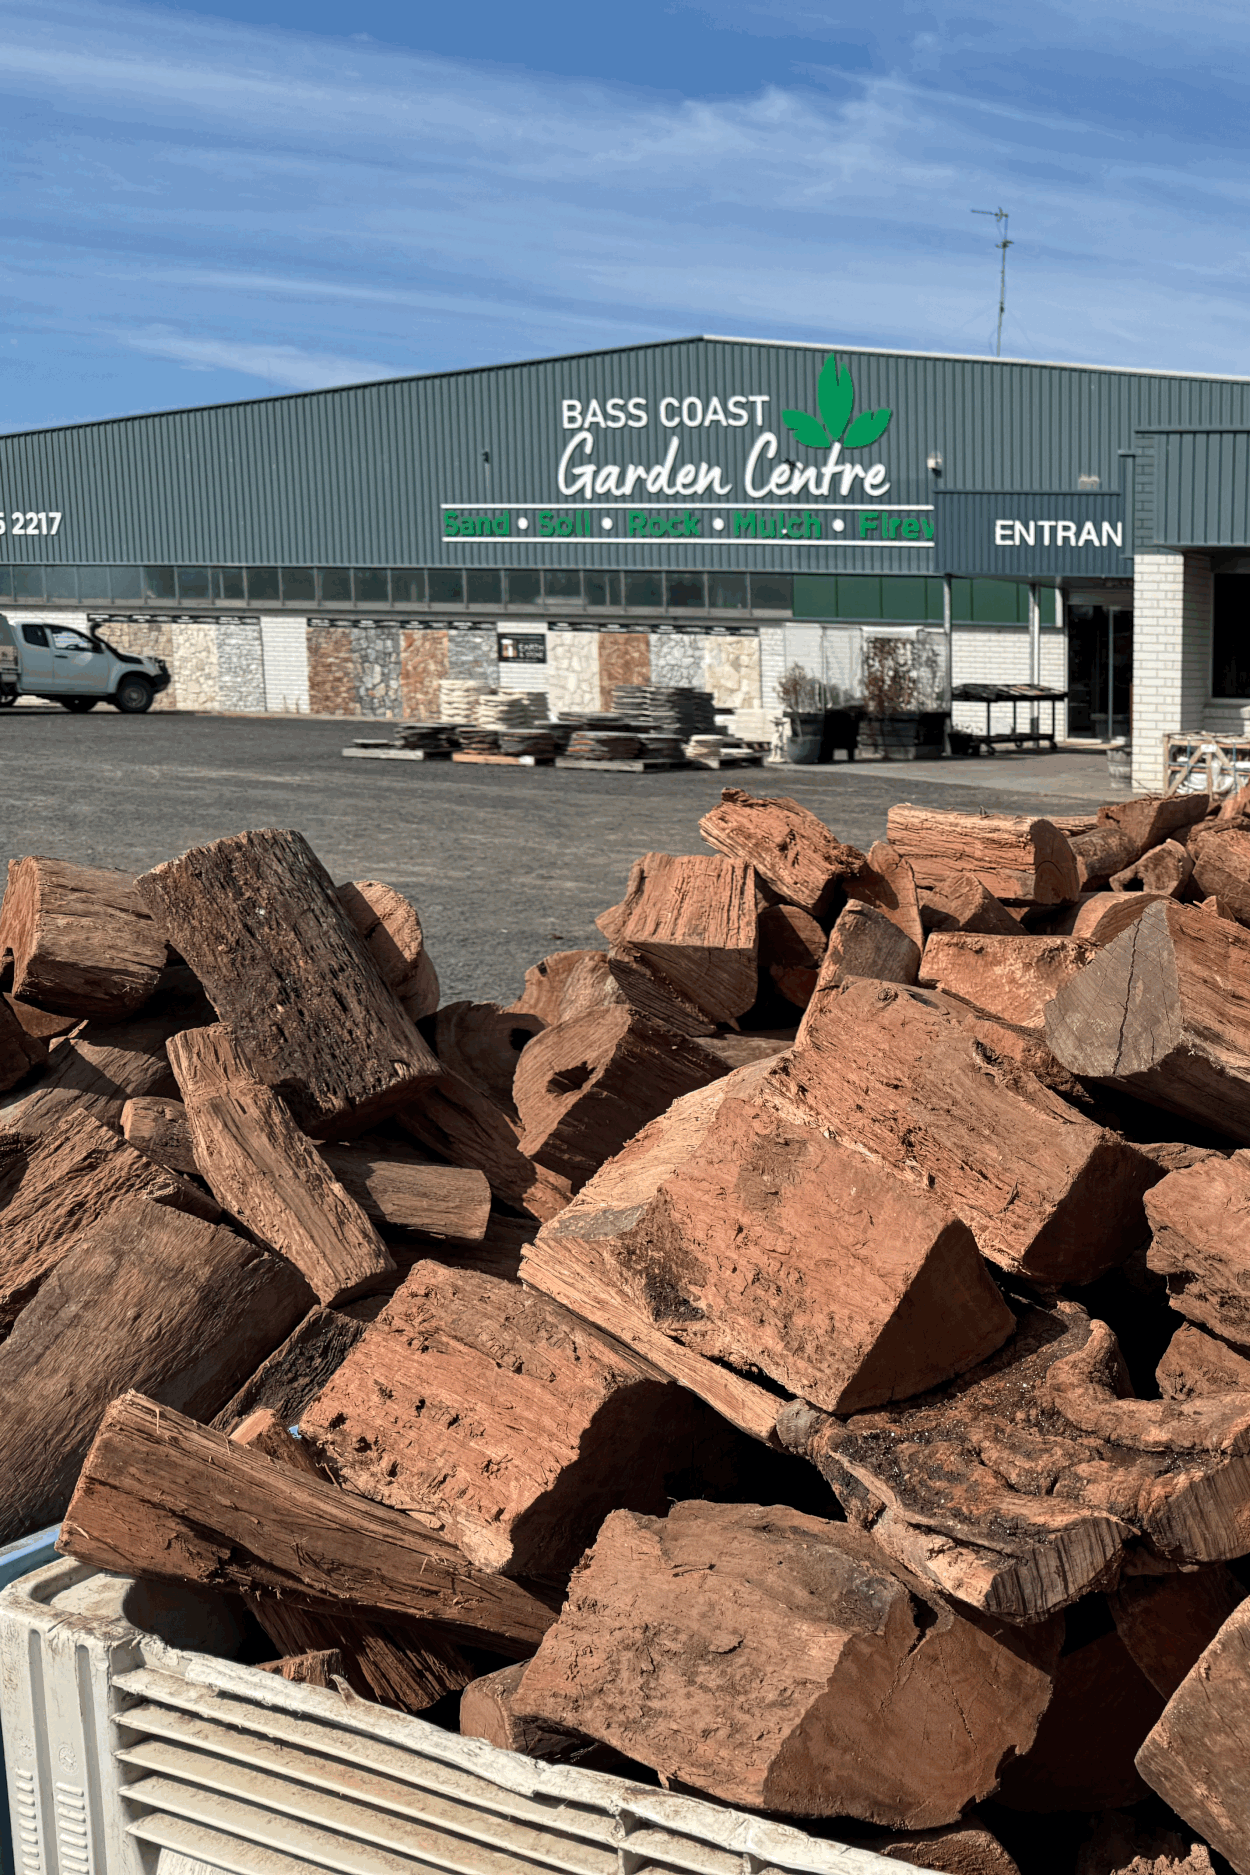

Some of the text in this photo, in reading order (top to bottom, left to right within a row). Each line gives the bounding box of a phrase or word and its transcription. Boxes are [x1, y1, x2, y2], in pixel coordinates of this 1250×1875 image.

[562, 395, 770, 429] BASS COAST
[557, 430, 891, 499] Garden Centre
[12, 511, 62, 535] 2217
[443, 510, 510, 537] Sand
[538, 510, 591, 537] Soil
[628, 510, 700, 537] Rock
[733, 511, 821, 538] Mulch
[995, 519, 1122, 547] ENTRAN
